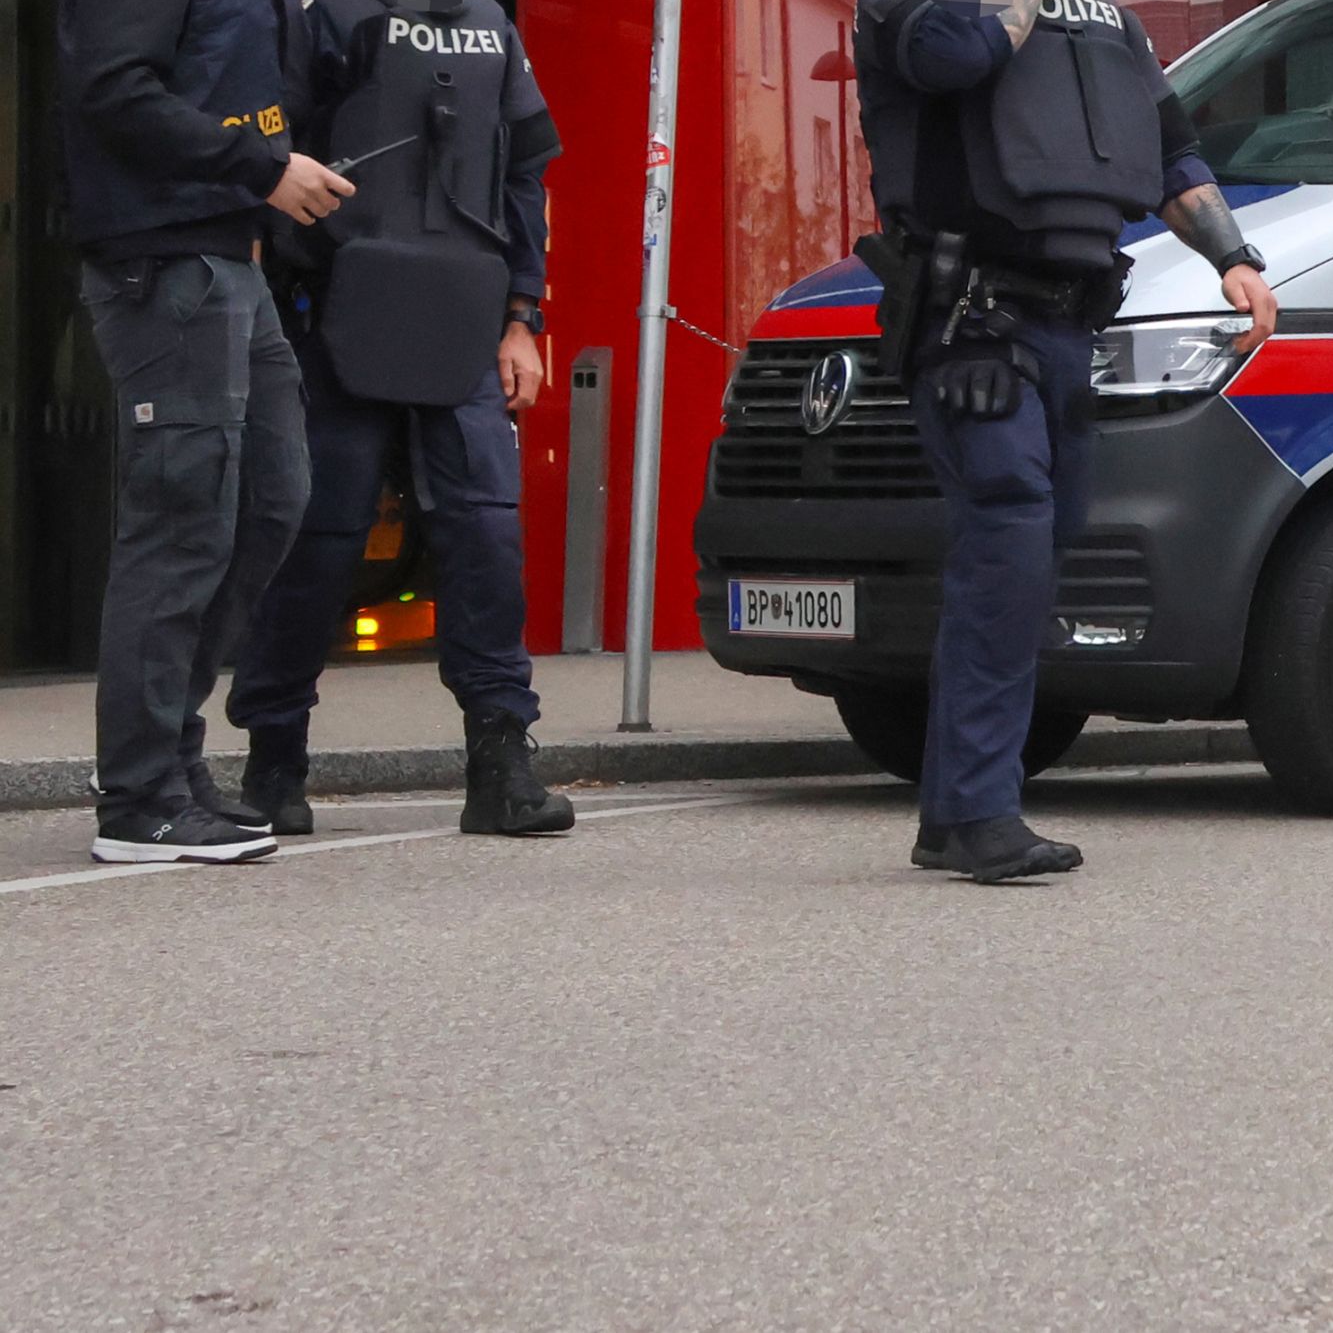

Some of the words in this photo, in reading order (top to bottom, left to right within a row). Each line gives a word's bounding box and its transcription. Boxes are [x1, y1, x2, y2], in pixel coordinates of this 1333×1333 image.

[388, 17, 504, 54] POLIZEI
[747, 589, 769, 626] BP
[784, 590, 842, 628] 41080
